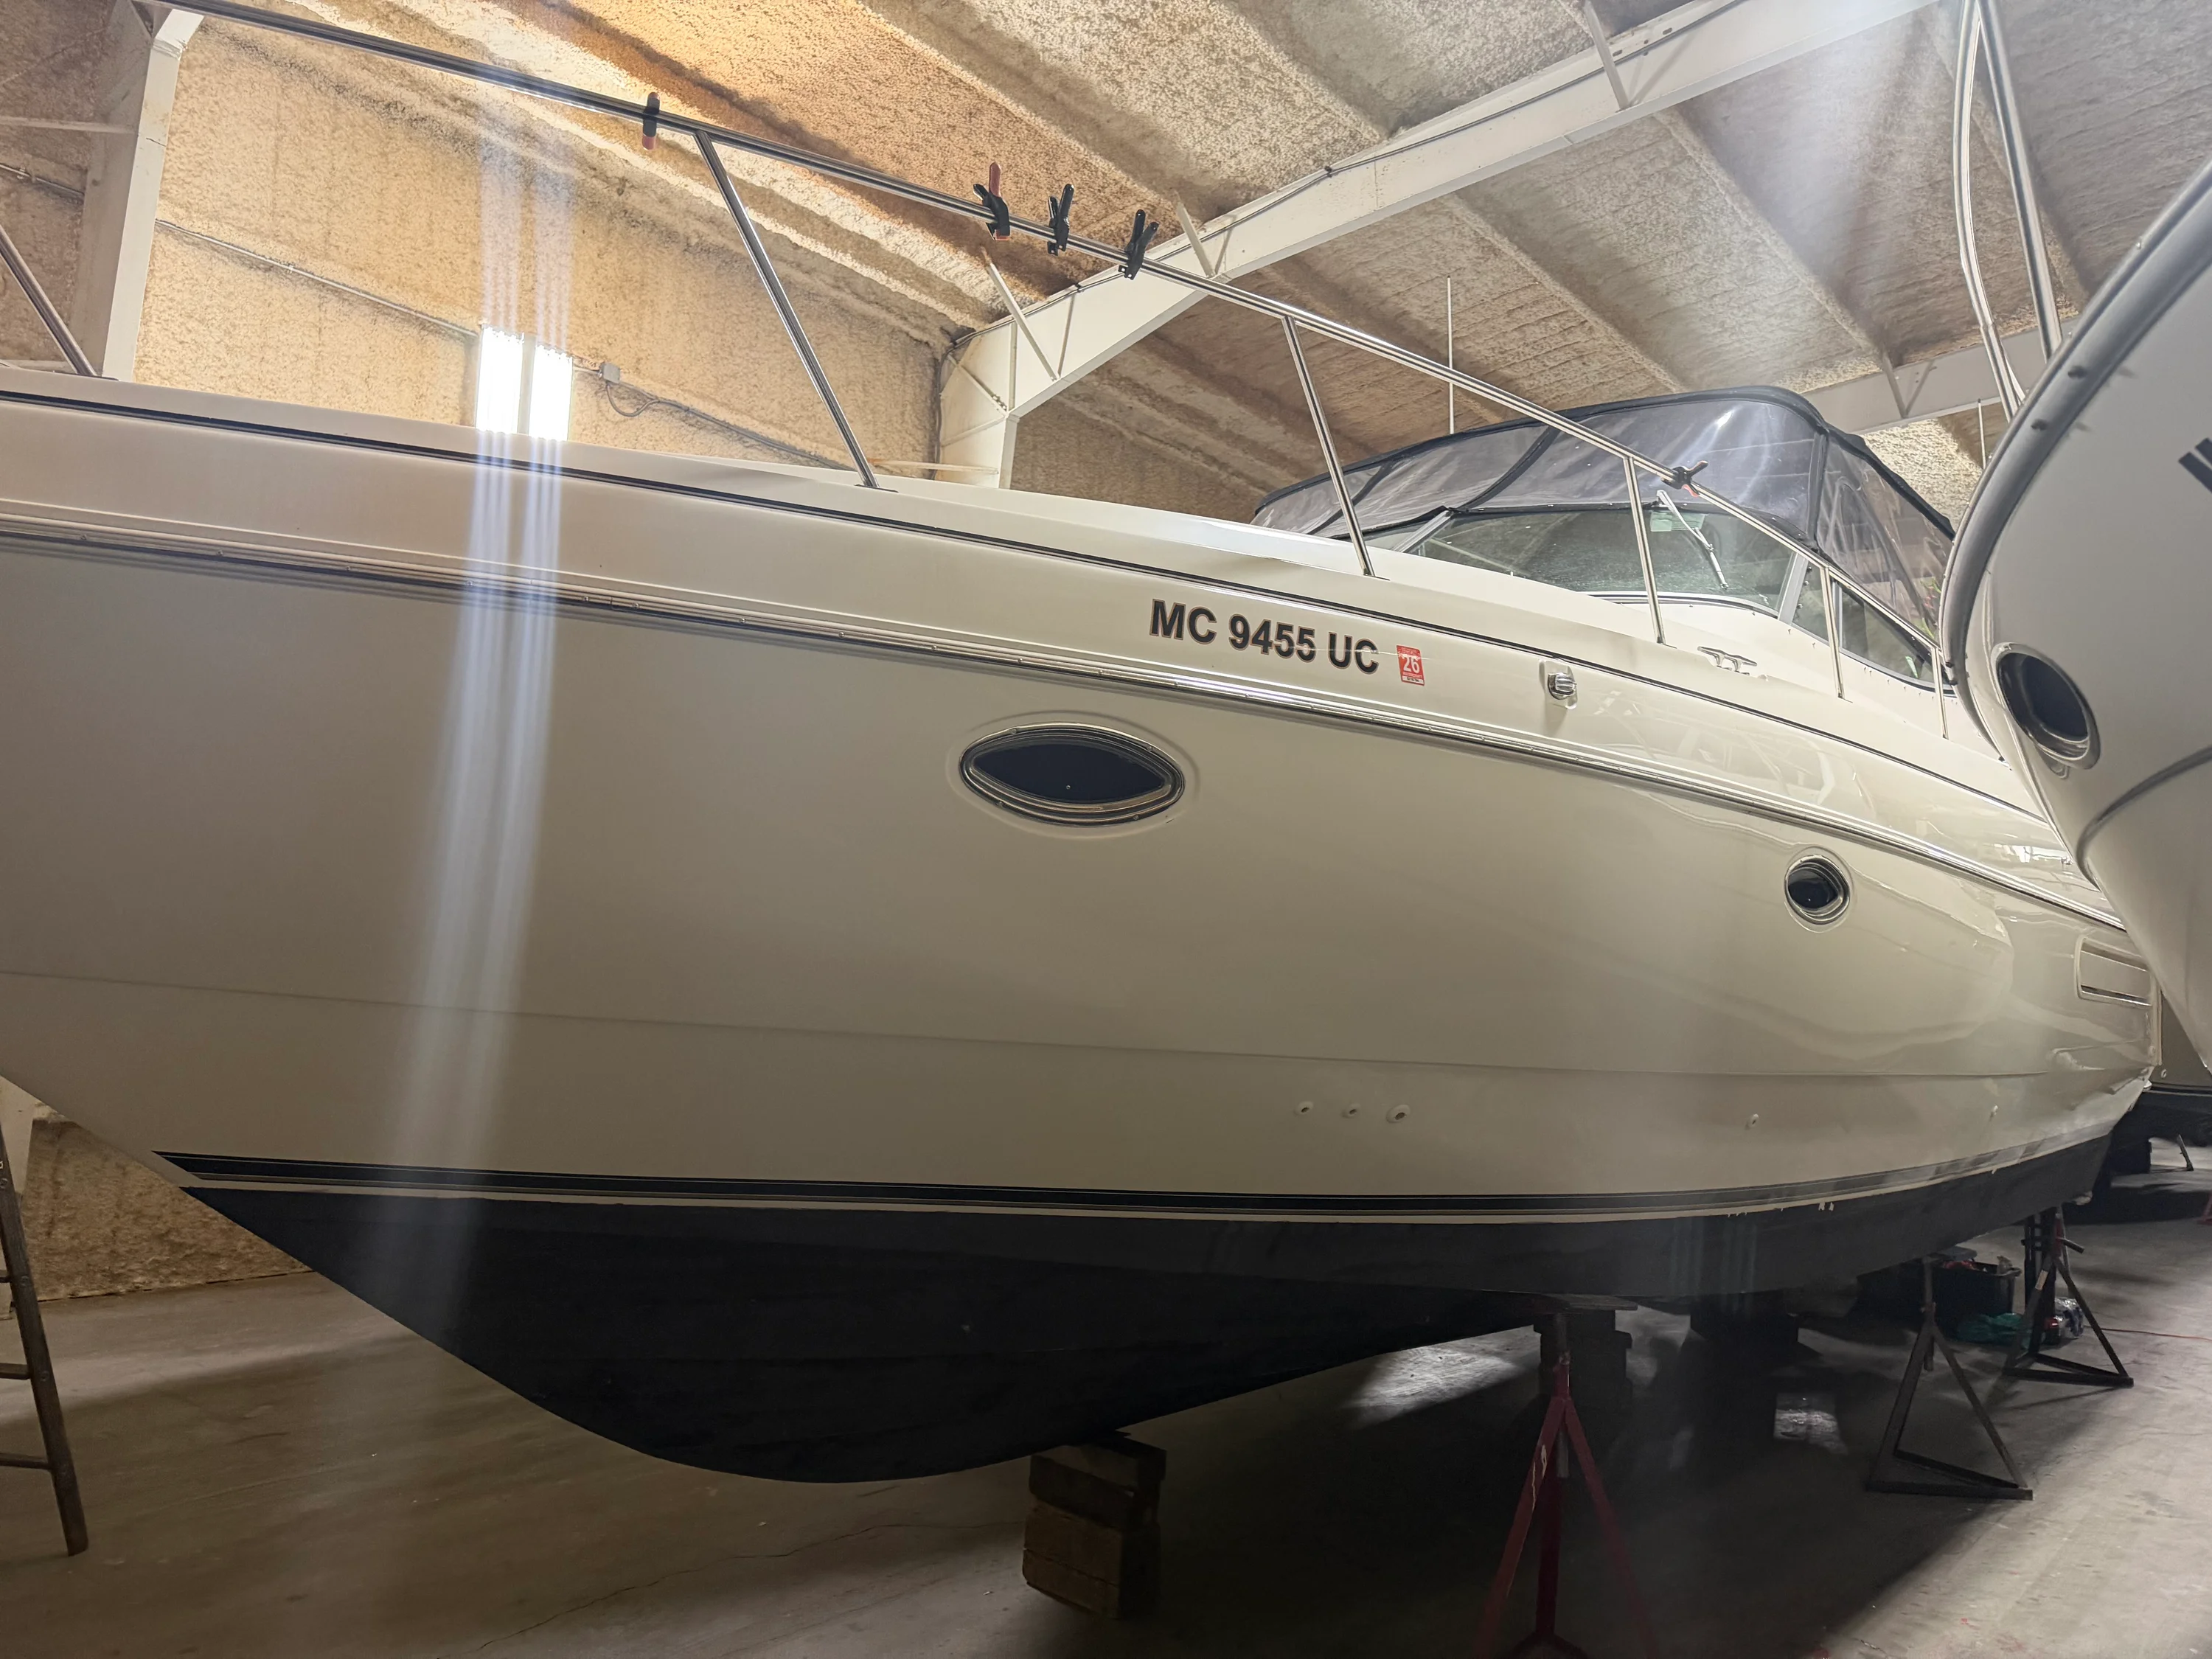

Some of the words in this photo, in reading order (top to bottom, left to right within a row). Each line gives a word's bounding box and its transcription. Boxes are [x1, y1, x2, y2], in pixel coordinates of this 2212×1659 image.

[1150, 598, 1217, 644] MC
[1228, 613, 1317, 663] 9455
[1328, 631, 1380, 675] UC
[1402, 655, 1420, 674] 26
